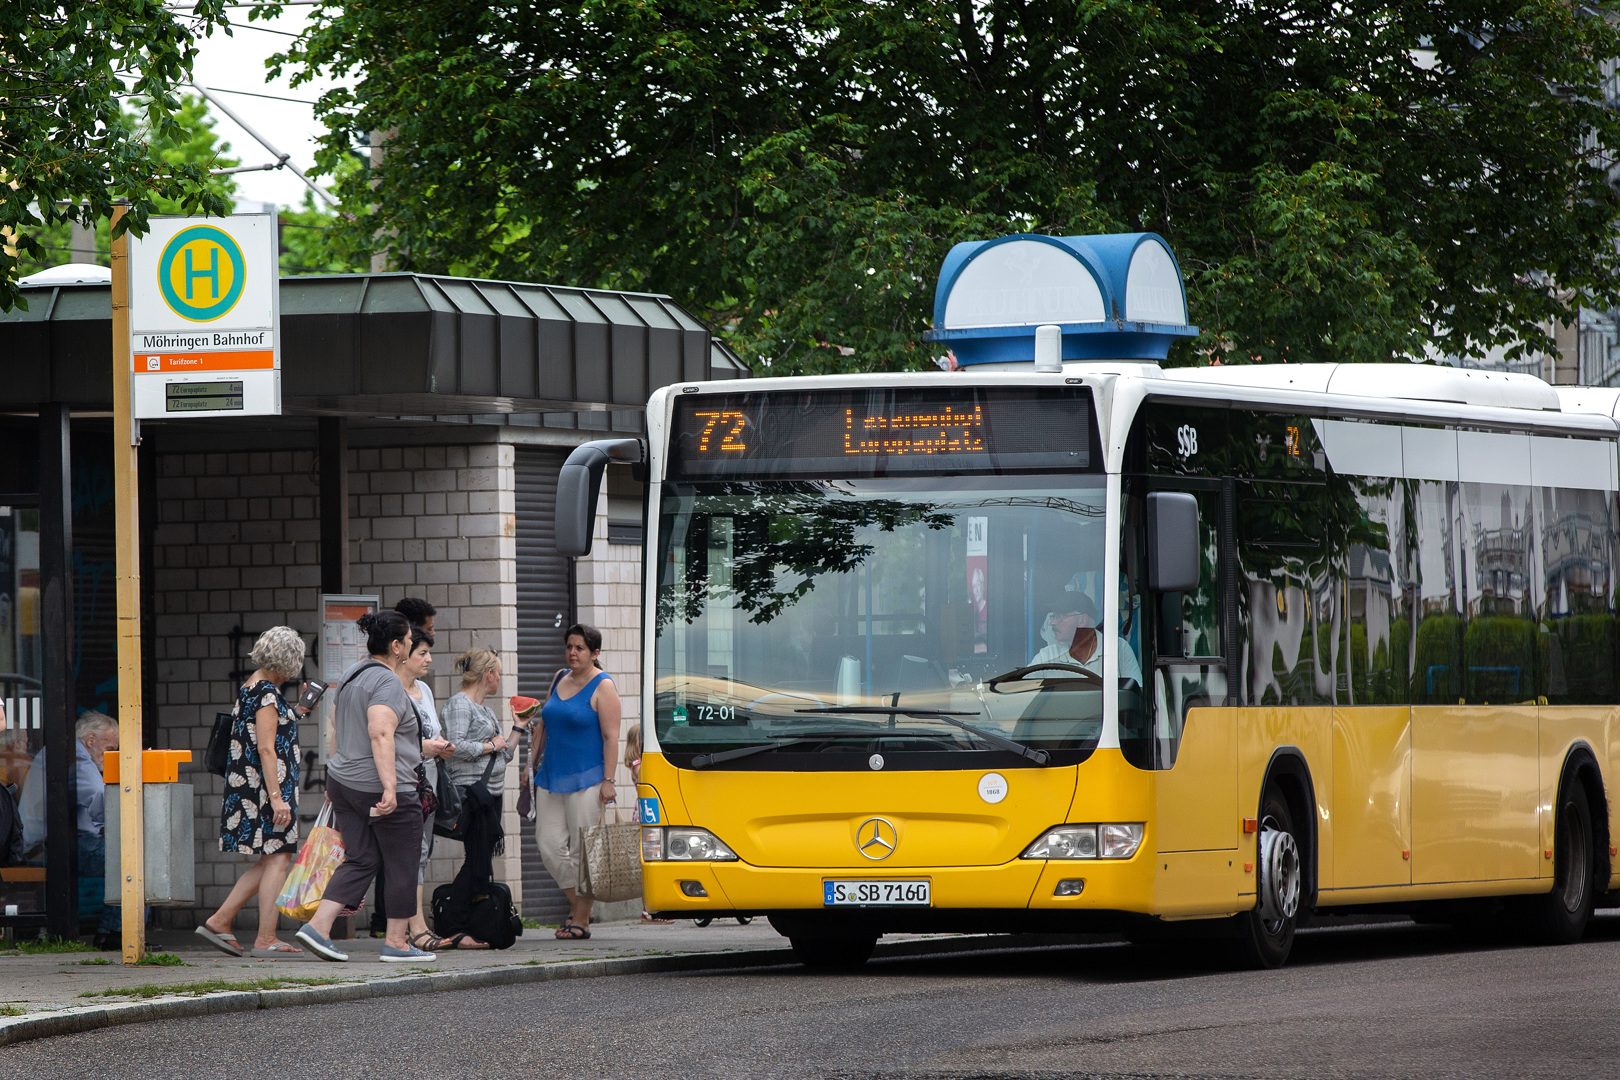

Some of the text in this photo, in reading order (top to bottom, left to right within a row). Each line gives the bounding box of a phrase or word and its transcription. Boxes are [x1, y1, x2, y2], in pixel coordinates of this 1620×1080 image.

[184, 247, 219, 300] H
[143, 332, 265, 350] Möhringen Bahnhof
[169, 358, 198, 366] Tarifzone
[172, 385, 180, 394] 72
[180, 386, 208, 394] Europaplatz
[229, 384, 233, 392] 4
[172, 399, 180, 408] 72
[180, 401, 208, 409] Europaplatz
[225, 398, 233, 406] 24
[695, 412, 746, 451] 72
[1177, 424, 1198, 457] SSB
[1286, 426, 1300, 455] 72
[697, 705, 735, 720] 72-01
[884, 884, 927, 901] 7160
